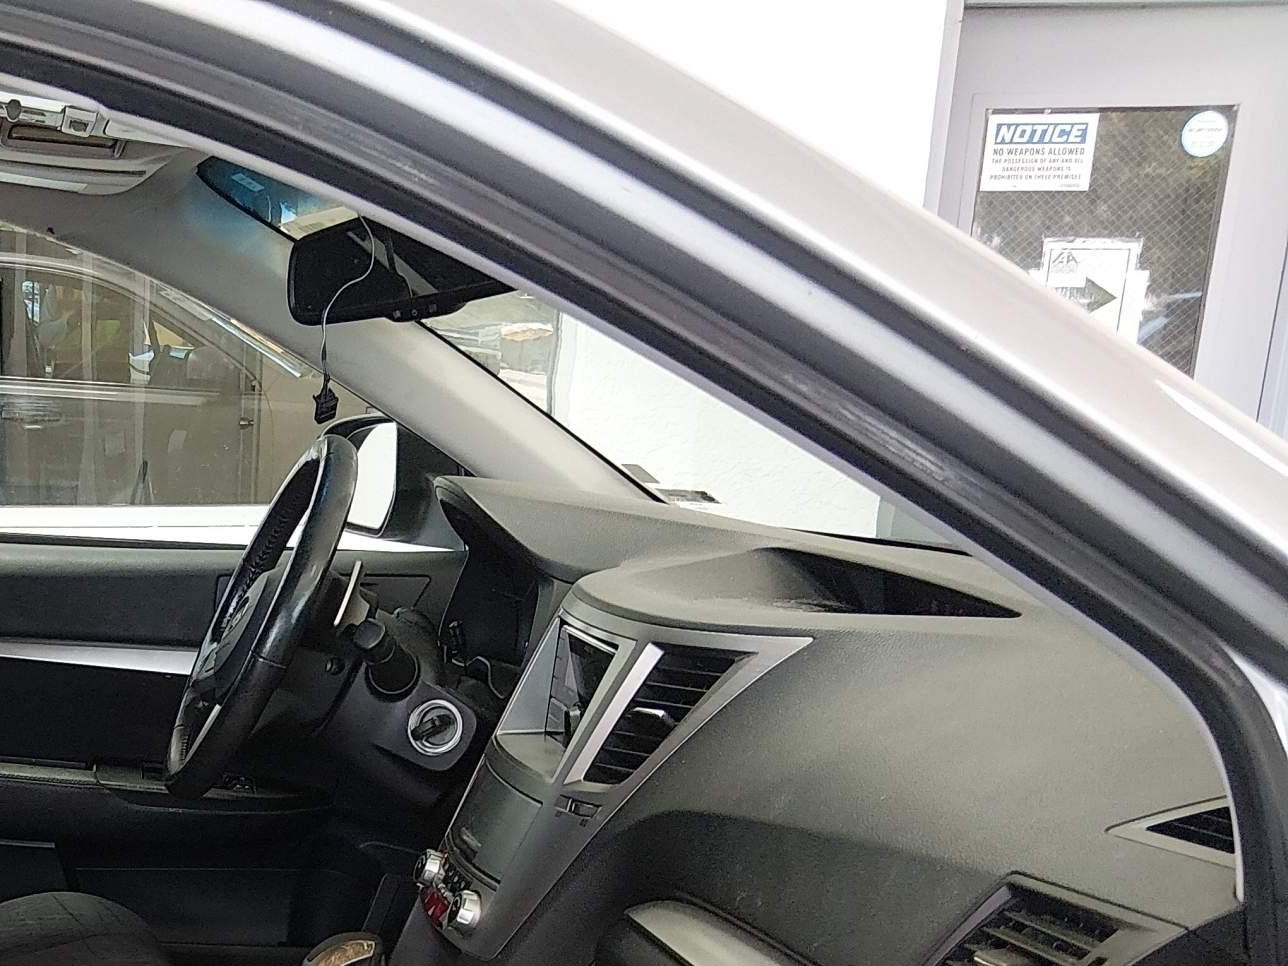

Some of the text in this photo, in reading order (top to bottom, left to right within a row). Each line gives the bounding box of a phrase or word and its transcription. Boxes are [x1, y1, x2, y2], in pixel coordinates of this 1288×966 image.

[996, 124, 1087, 143] NOTICE
[992, 147, 1085, 156] NO WEAPONS ALLOWED
